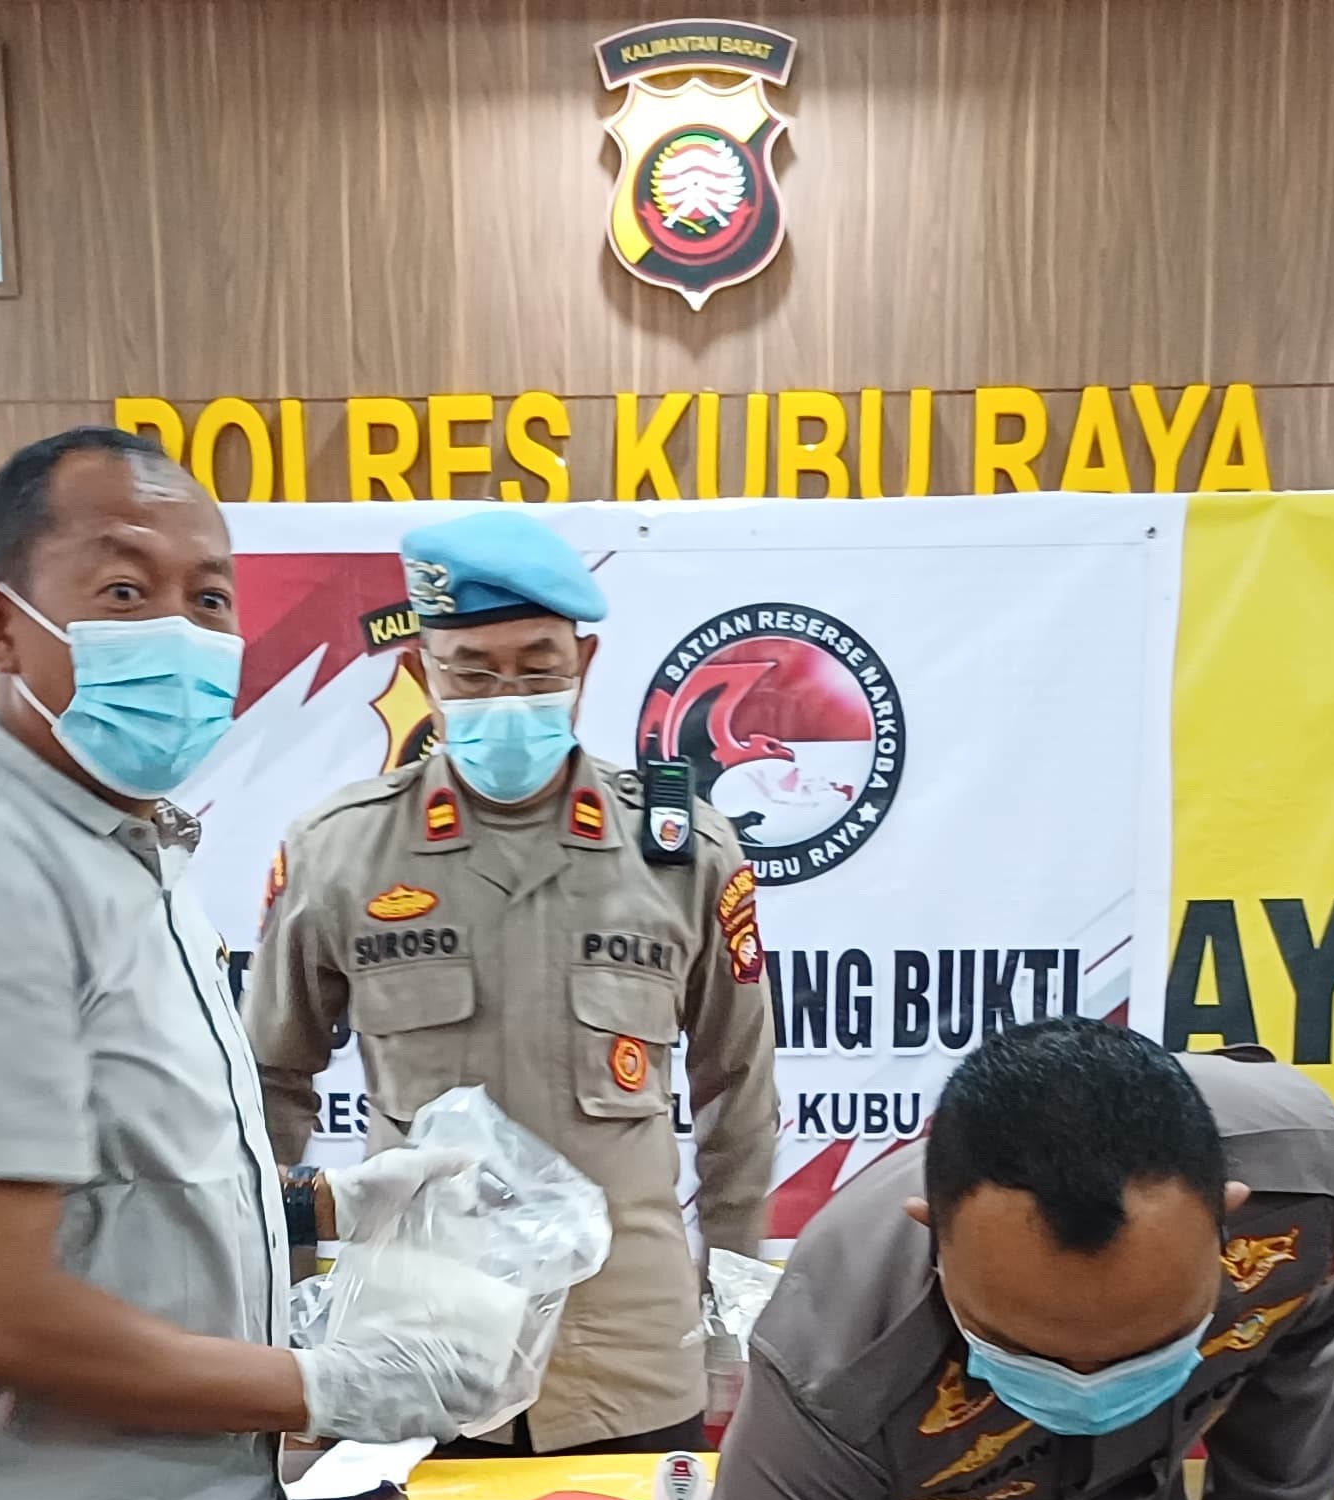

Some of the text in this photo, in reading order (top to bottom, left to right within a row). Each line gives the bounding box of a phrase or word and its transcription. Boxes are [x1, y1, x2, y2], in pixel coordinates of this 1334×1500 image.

[620, 35, 774, 64] KALIMANTAN BARAT
[615, 388, 932, 502] KUBU
[975, 383, 1272, 495] RAYA
[664, 613, 752, 682] SATUAN
[758, 610, 867, 667] RESERSE
[743, 821, 866, 879] UBU RAYA
[798, 1092, 921, 1135] KUBU
